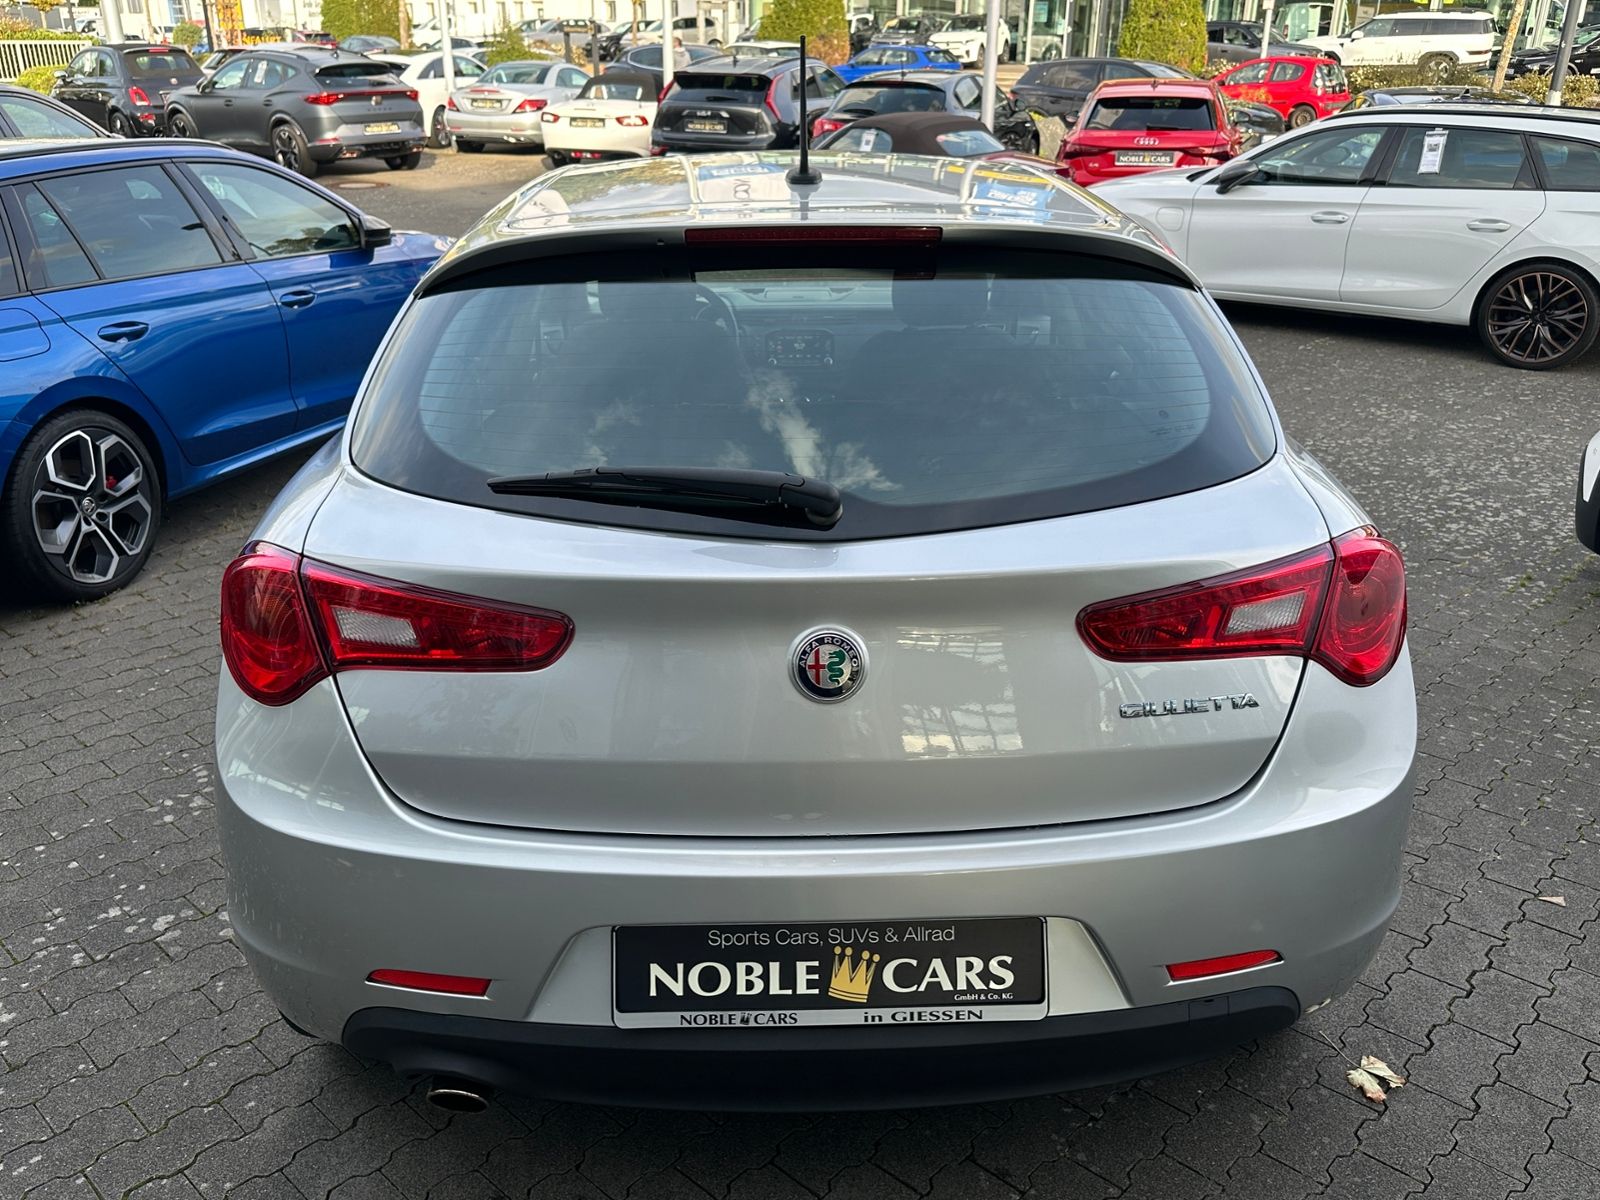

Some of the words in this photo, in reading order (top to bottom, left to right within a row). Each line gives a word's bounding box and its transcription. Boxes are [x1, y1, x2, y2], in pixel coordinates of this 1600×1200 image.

[799, 640, 820, 668] ALFA
[824, 636, 859, 667] ROMEO
[1119, 693, 1260, 718] GIULIETTA
[707, 929, 771, 948] Sports
[775, 929, 824, 946] Cars,
[827, 928, 879, 945] SUVs
[884, 927, 900, 943] &
[903, 925, 956, 943] Allrad
[649, 961, 820, 997] NOBLE
[882, 955, 1015, 993] CARS
[953, 993, 978, 1001] GmbH
[980, 993, 986, 1001] &
[988, 993, 1001, 1001] Co.
[1002, 992, 1013, 1000] KG
[679, 1013, 737, 1026] NOBLE
[753, 1012, 798, 1025] CARS
[863, 1011, 883, 1024] in
[890, 1009, 984, 1023] GIESSEN
